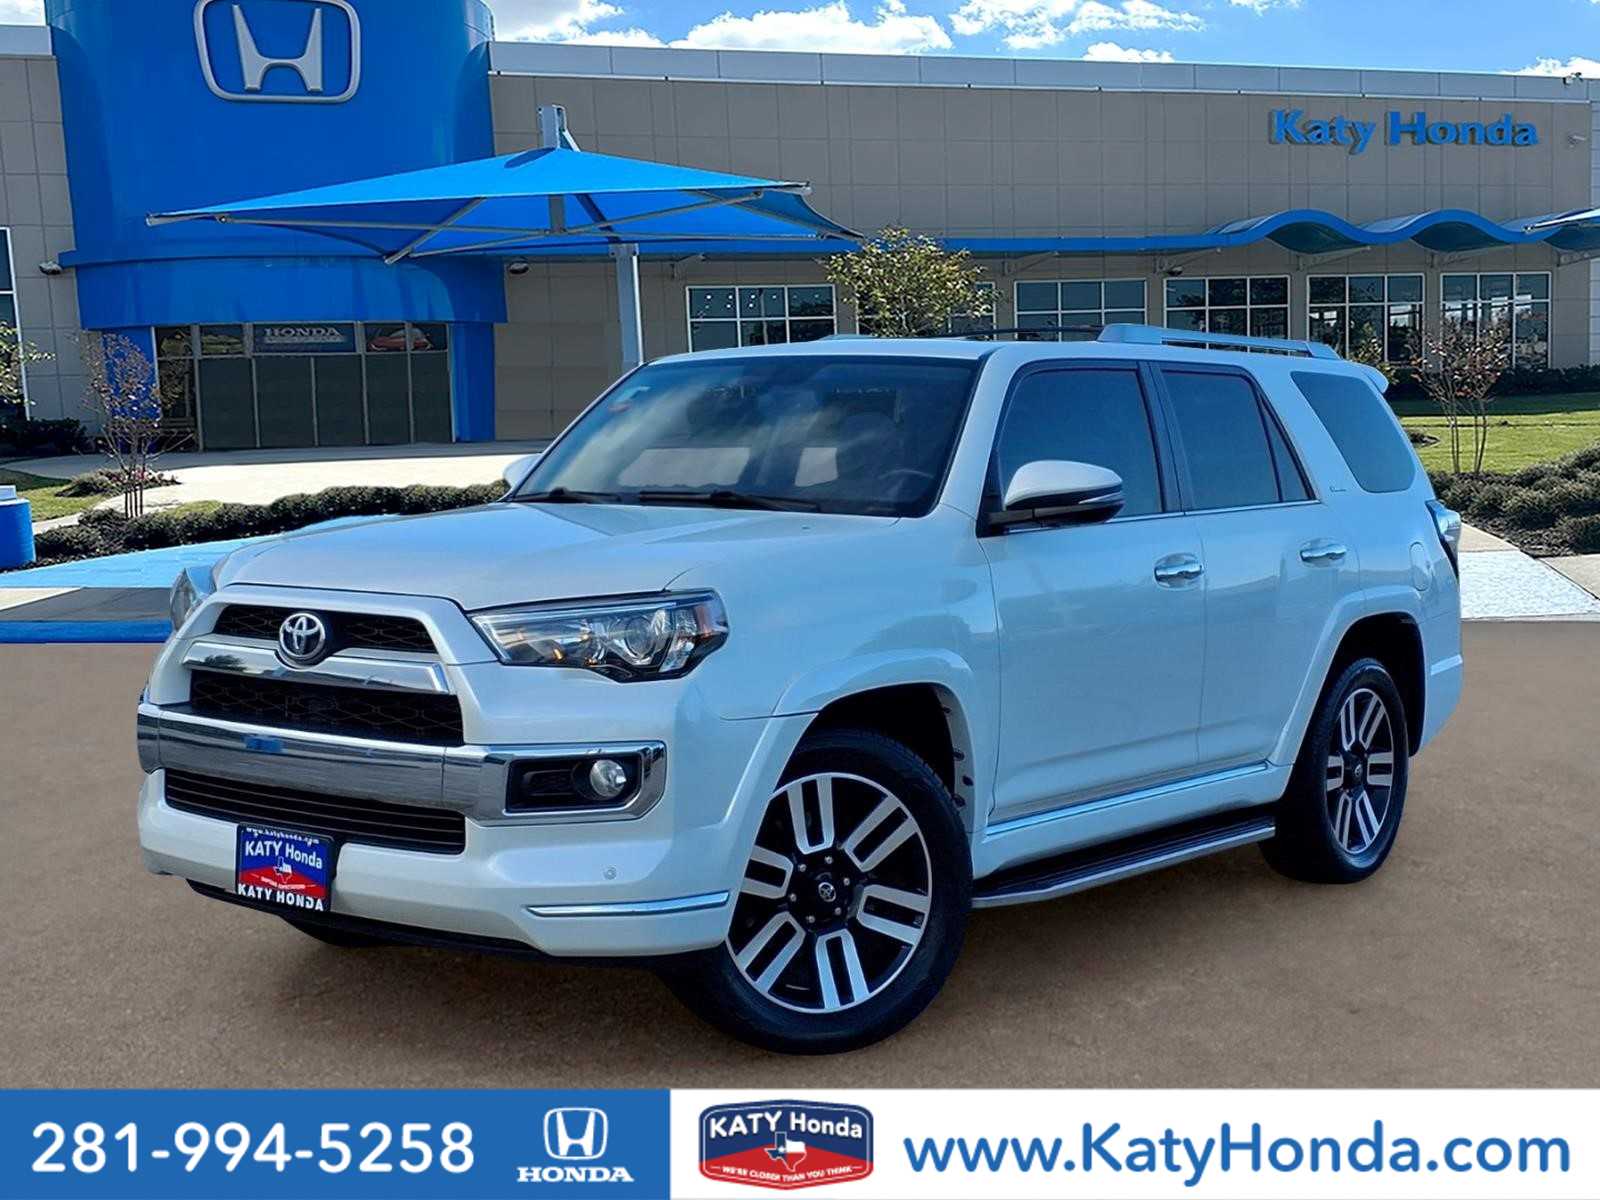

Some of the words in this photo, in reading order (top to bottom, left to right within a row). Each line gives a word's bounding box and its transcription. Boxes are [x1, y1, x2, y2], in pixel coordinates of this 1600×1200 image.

[1270, 109, 1376, 155] Katy
[1384, 111, 1538, 146] Honda
[264, 326, 342, 337] HONDA
[245, 840, 282, 857] KATY
[285, 843, 322, 869] Honda
[238, 884, 273, 900] KATY
[276, 890, 324, 911] HONDA
